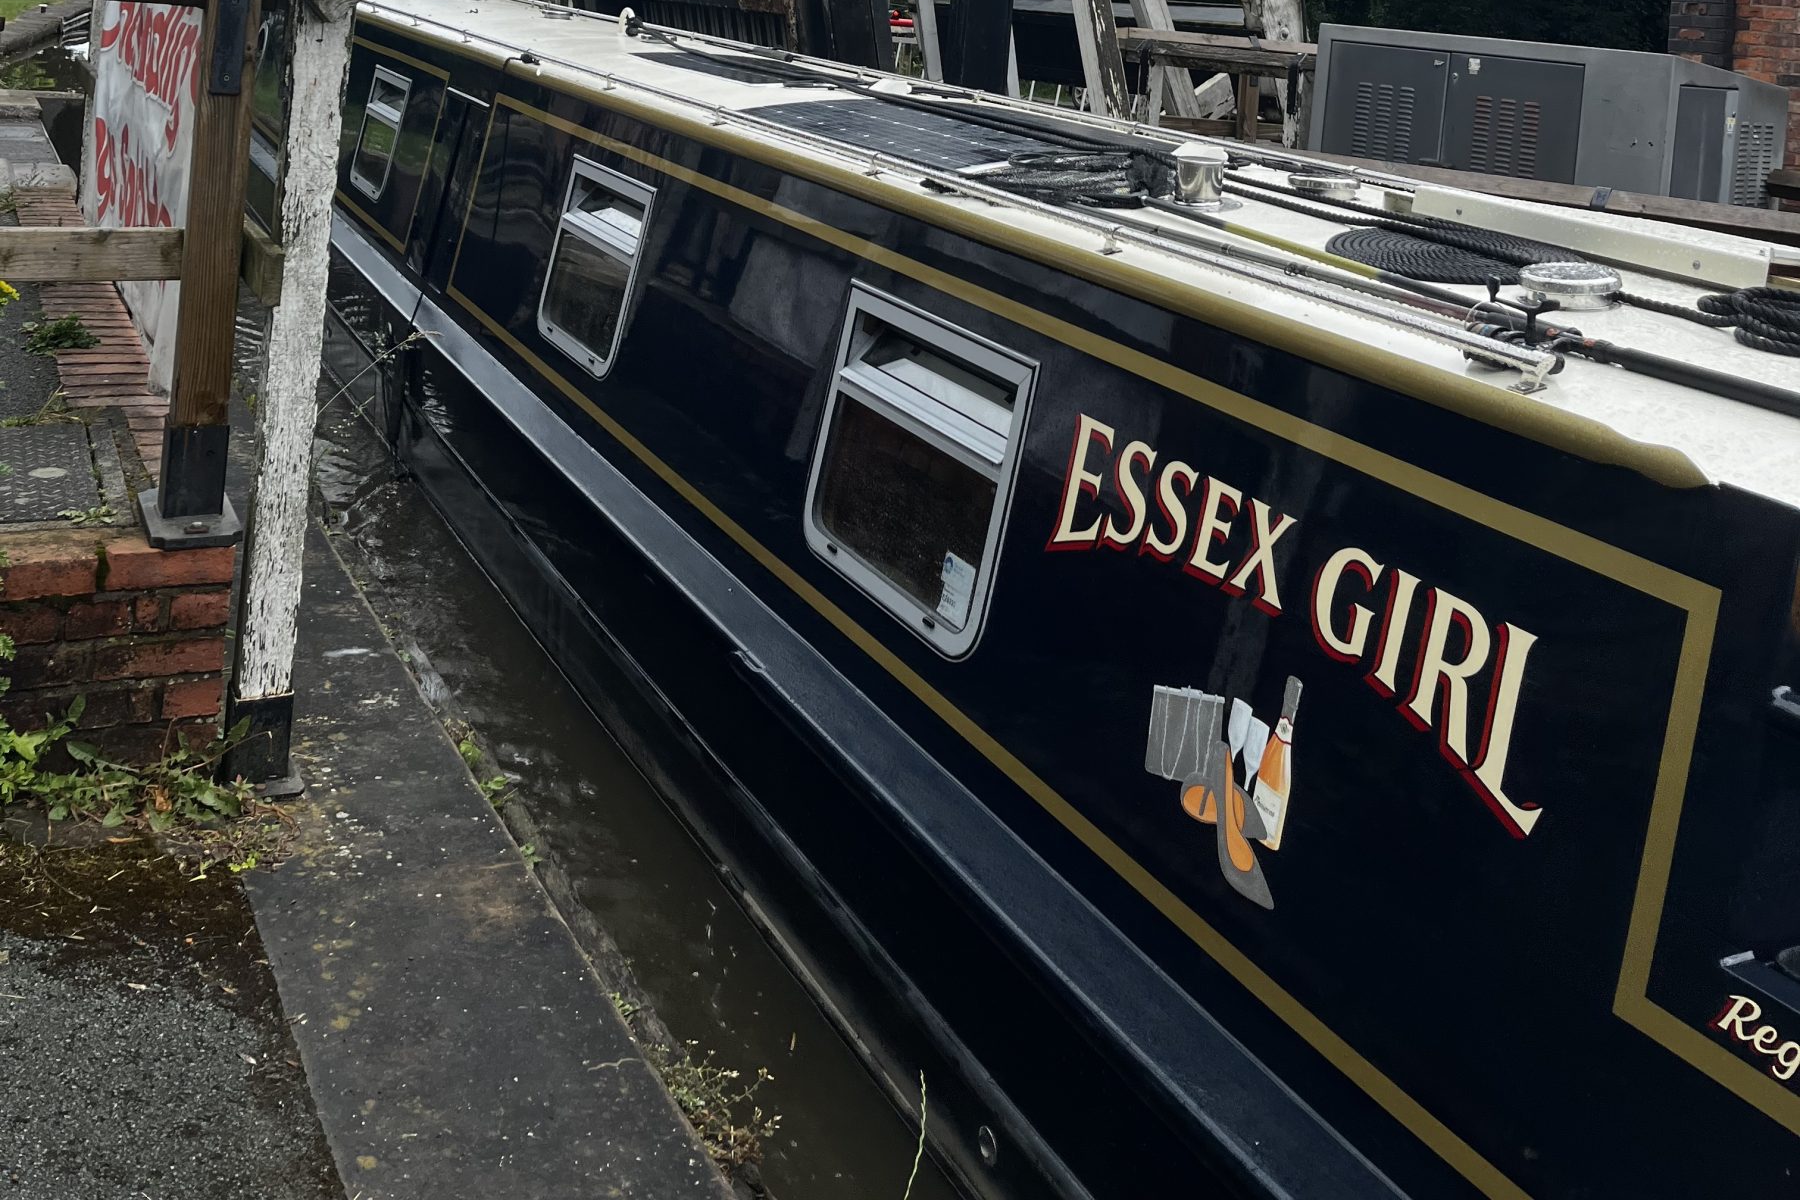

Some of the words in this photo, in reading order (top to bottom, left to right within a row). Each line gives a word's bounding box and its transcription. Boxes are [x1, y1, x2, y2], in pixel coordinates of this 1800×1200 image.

[1047, 413, 1297, 617] ESSEX
[1311, 547, 1543, 839] GIRL
[1710, 994, 1800, 1080] Reg
